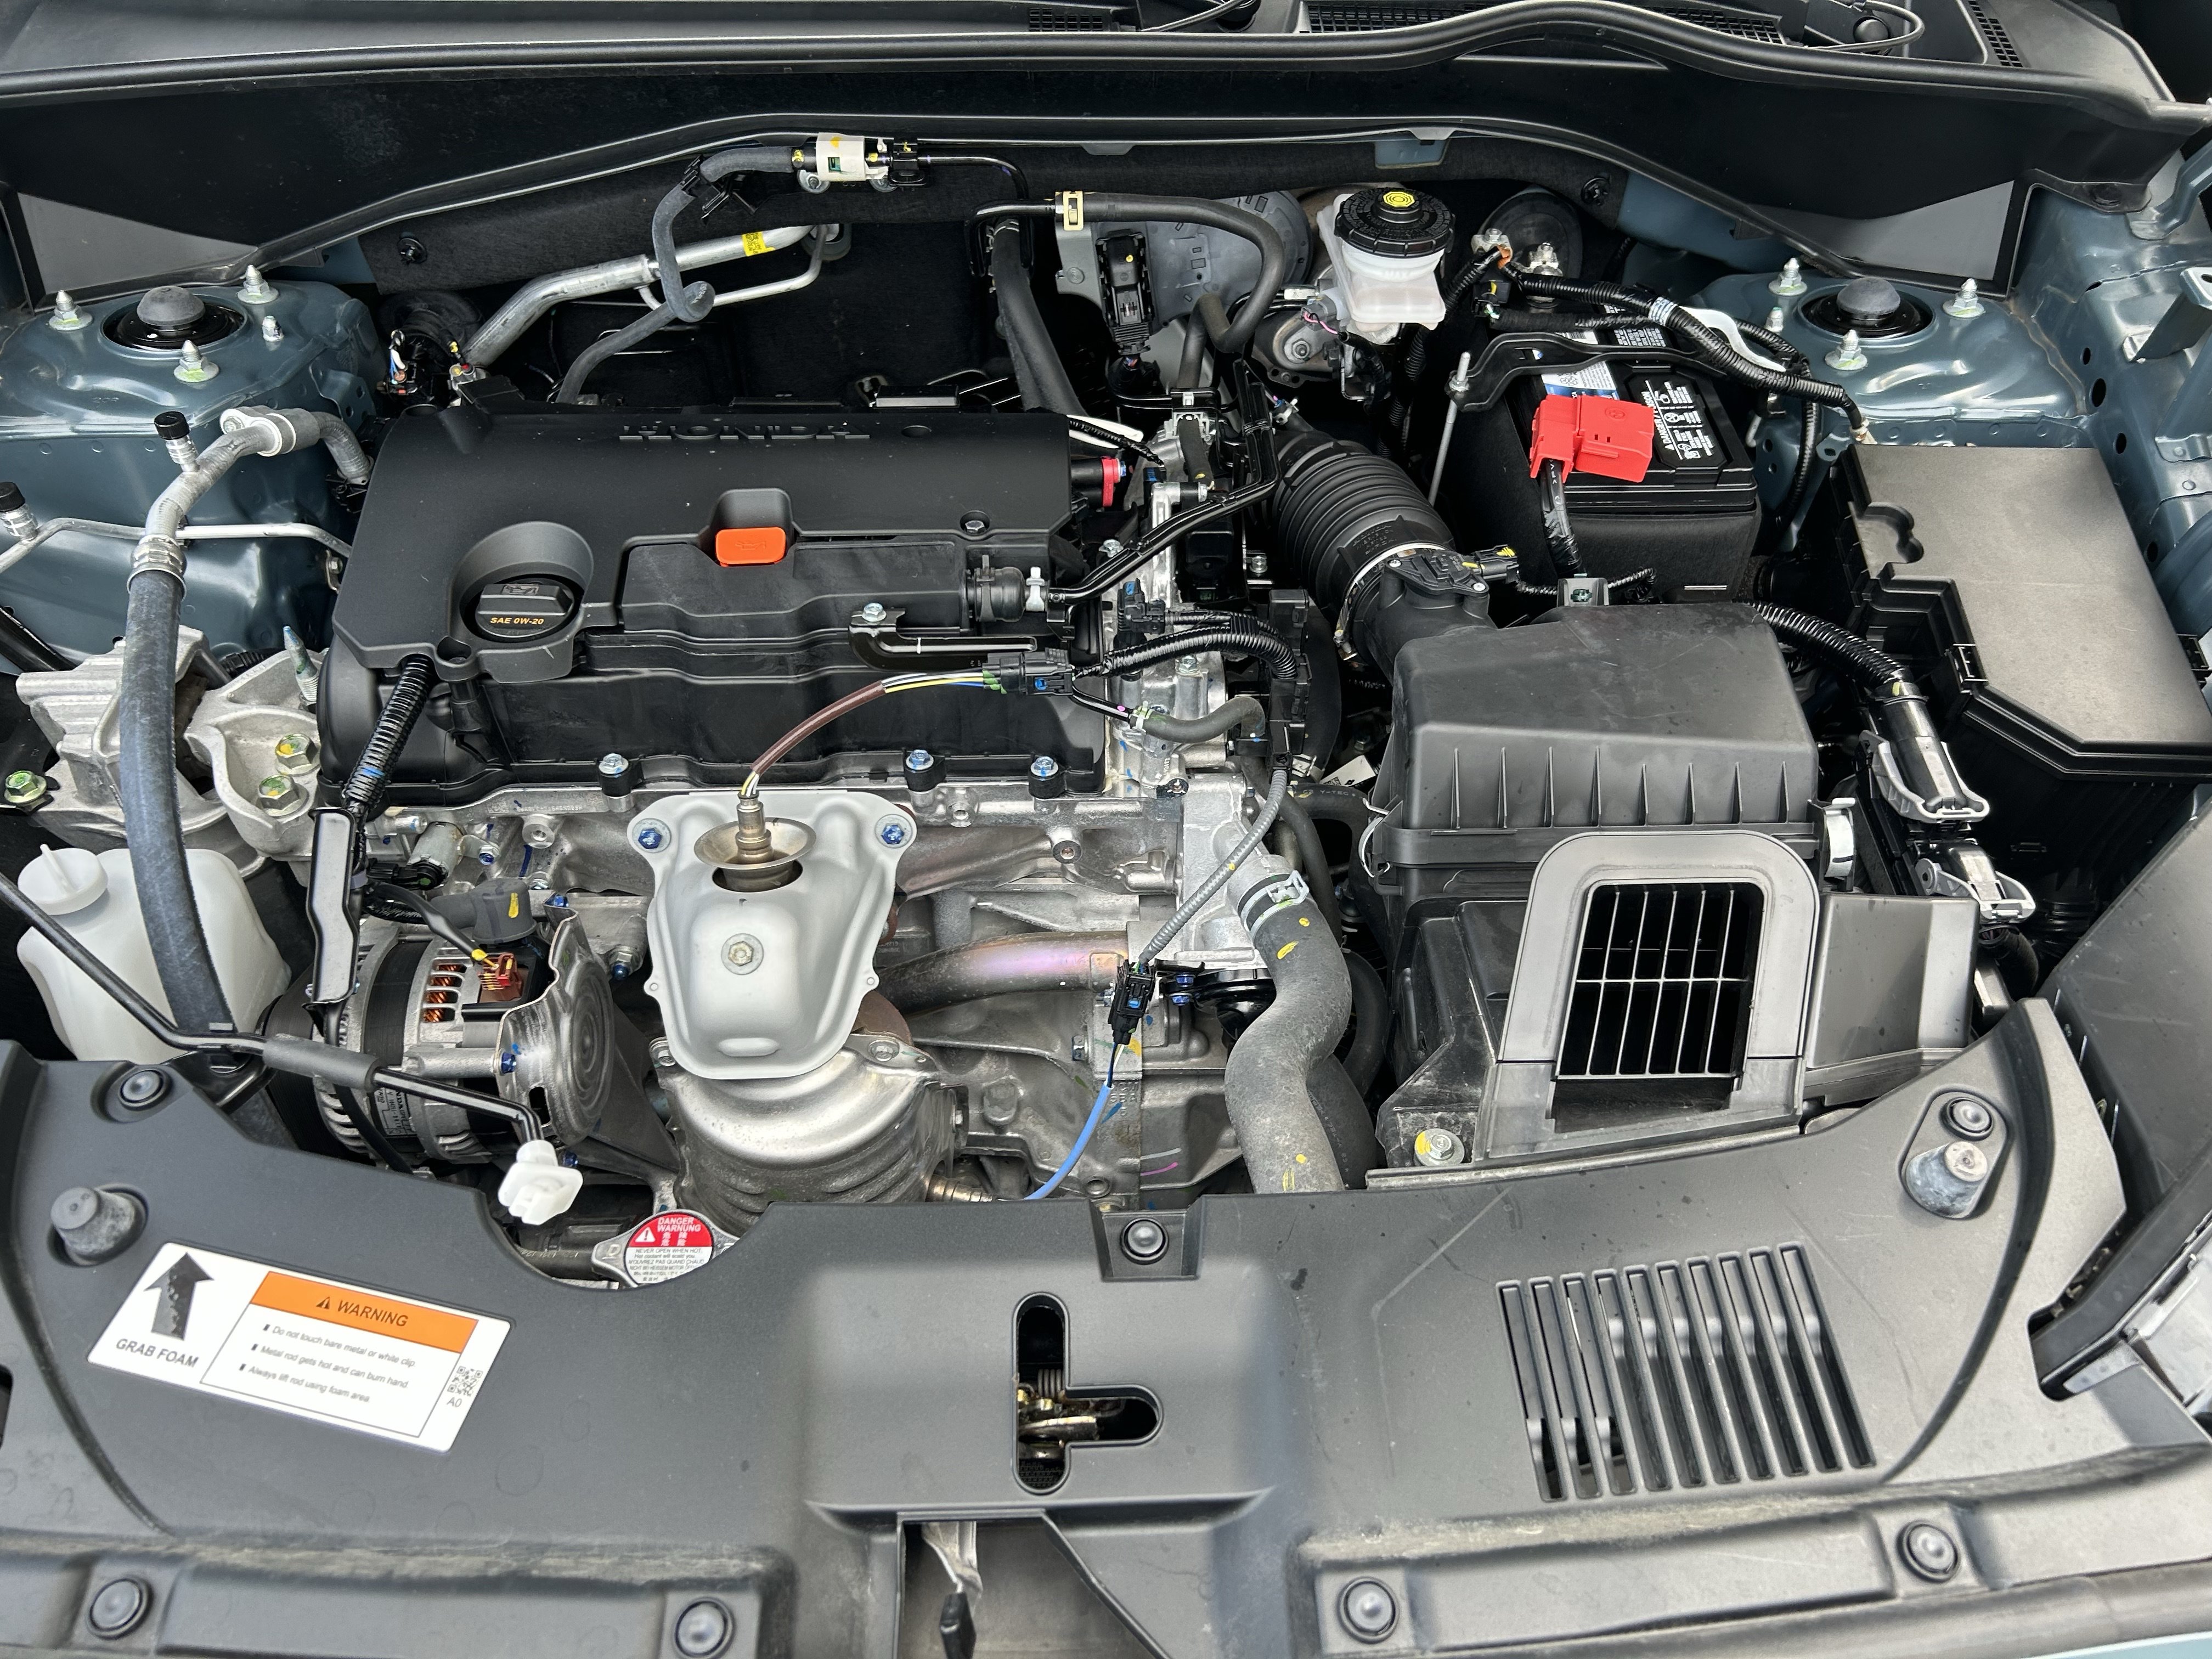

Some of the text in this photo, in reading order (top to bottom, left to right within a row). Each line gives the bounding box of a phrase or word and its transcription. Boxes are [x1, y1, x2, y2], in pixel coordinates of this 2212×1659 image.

[619, 426, 870, 439] HONDA
[1654, 419, 1672, 444] DANGER
[657, 1224, 701, 1232] WARNUNG
[337, 1300, 409, 1327] WARNING
[116, 1338, 199, 1367] GRAB FOAM
[272, 1326, 285, 1335] Do
[286, 1330, 300, 1339] not
[300, 1334, 323, 1344] touch
[324, 1339, 342, 1349] bare
[344, 1345, 367, 1355] metal
[378, 1352, 399, 1363] white
[400, 1357, 415, 1368] clip.
[248, 1366, 276, 1379] Always
[278, 1373, 289, 1382] lift
[290, 1377, 304, 1386] rod
[305, 1381, 327, 1393] using
[329, 1385, 349, 1396] foam
[260, 1346, 408, 1389] Metal rod gets hot and can burn hand.
[447, 1397, 462, 1407] A0
